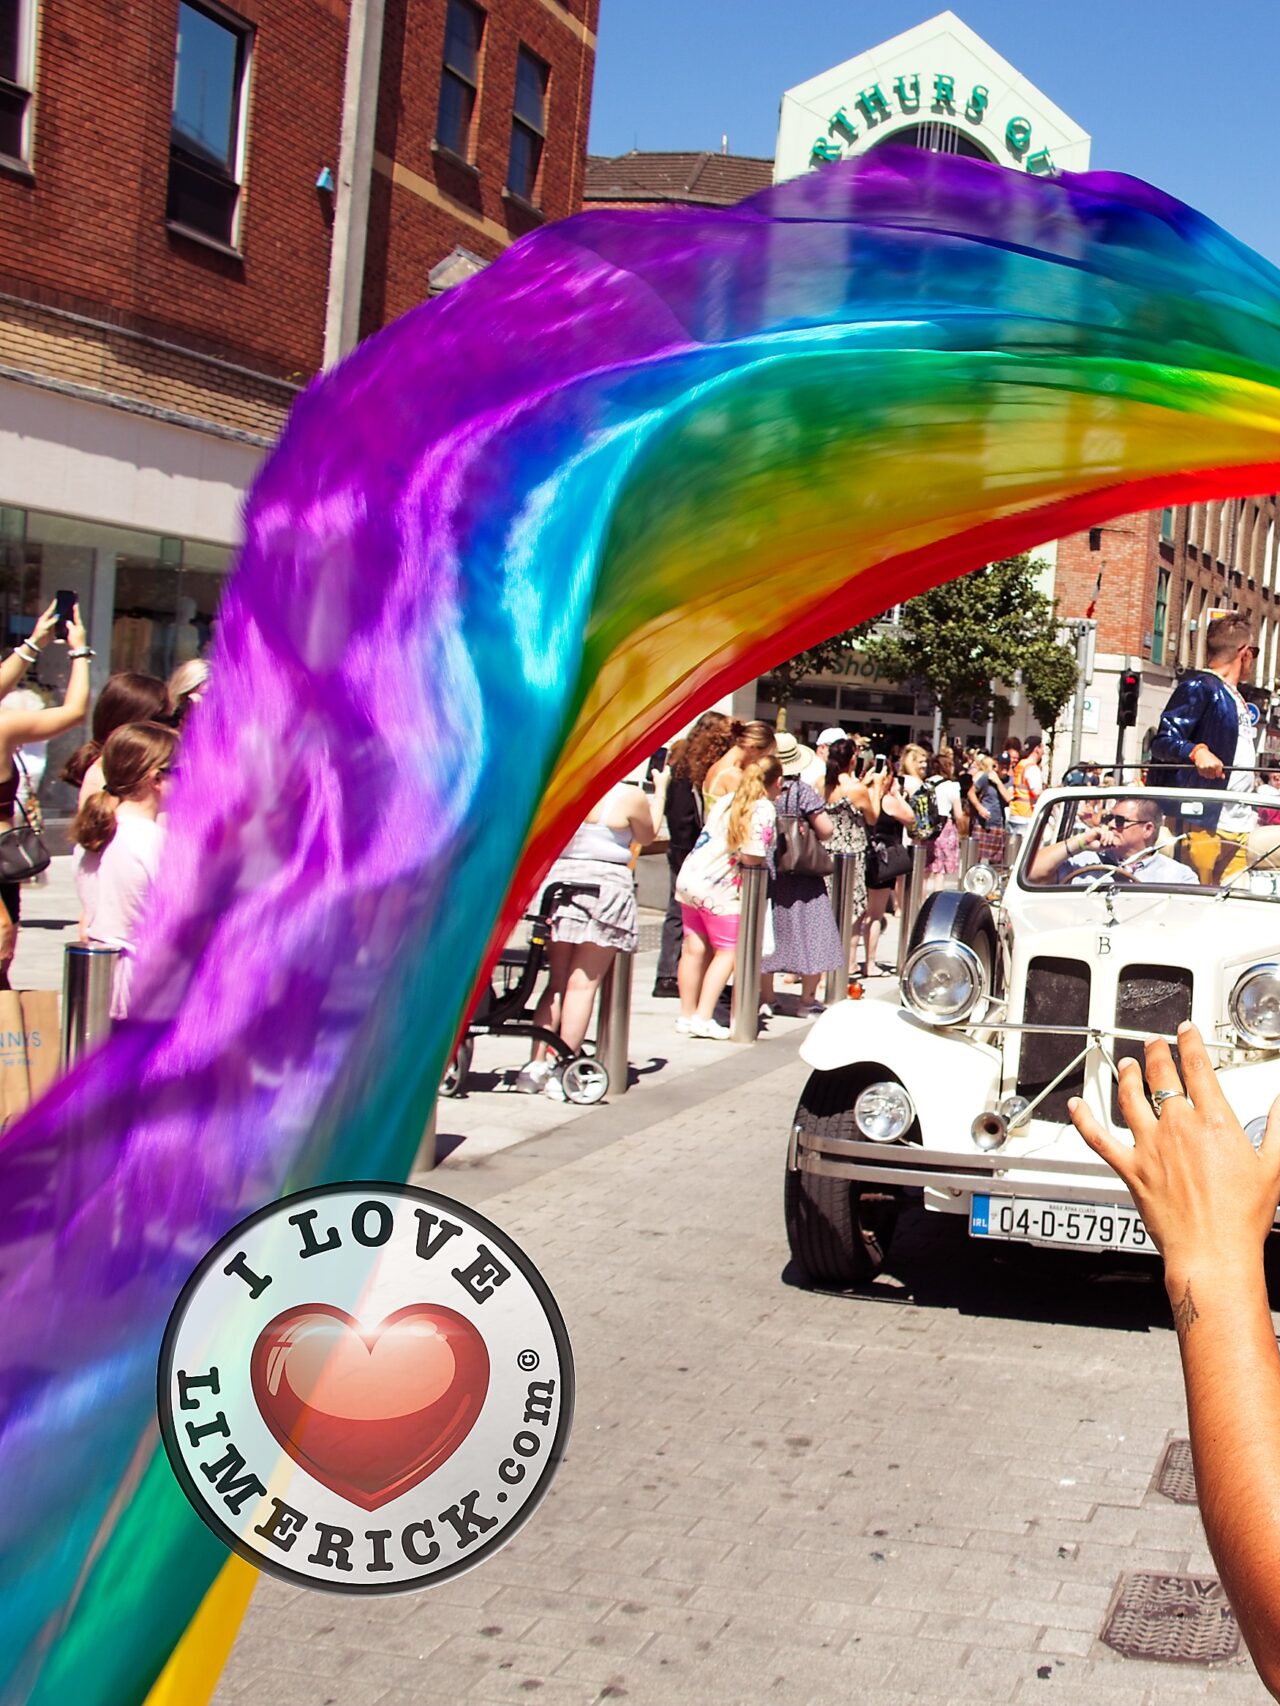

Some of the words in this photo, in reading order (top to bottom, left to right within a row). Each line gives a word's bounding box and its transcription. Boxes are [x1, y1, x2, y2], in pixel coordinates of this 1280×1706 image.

[810, 73, 990, 161] RTHURS
[972, 1218, 988, 1228] IRL
[1000, 1206, 1147, 1245] 04-D-57975
